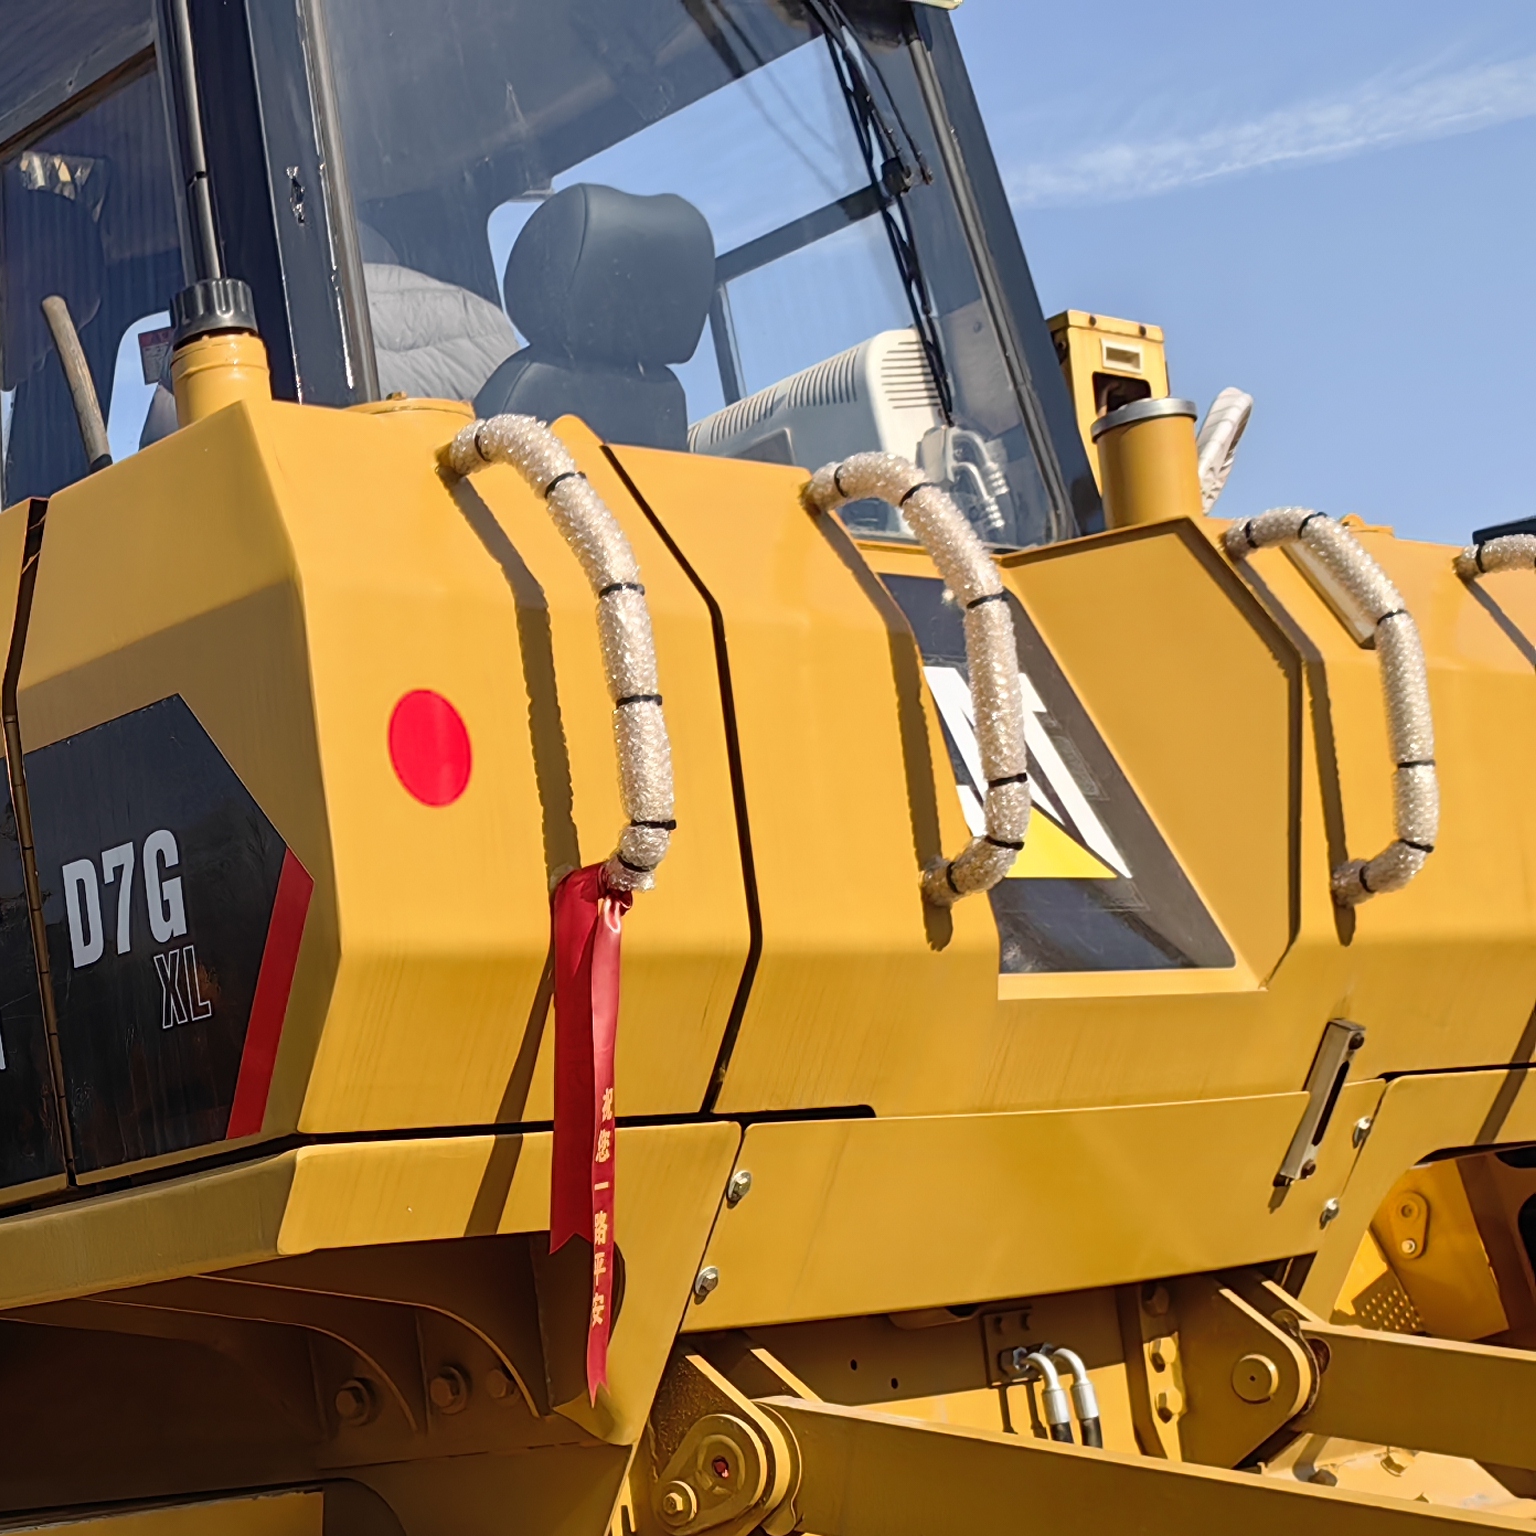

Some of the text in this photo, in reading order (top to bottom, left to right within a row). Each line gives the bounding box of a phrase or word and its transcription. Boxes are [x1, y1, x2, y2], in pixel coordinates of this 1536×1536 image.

[62, 829, 187, 969] D7G
[154, 945, 212, 1029] XL
[590, 1087, 615, 1327] 祝您一路平安
